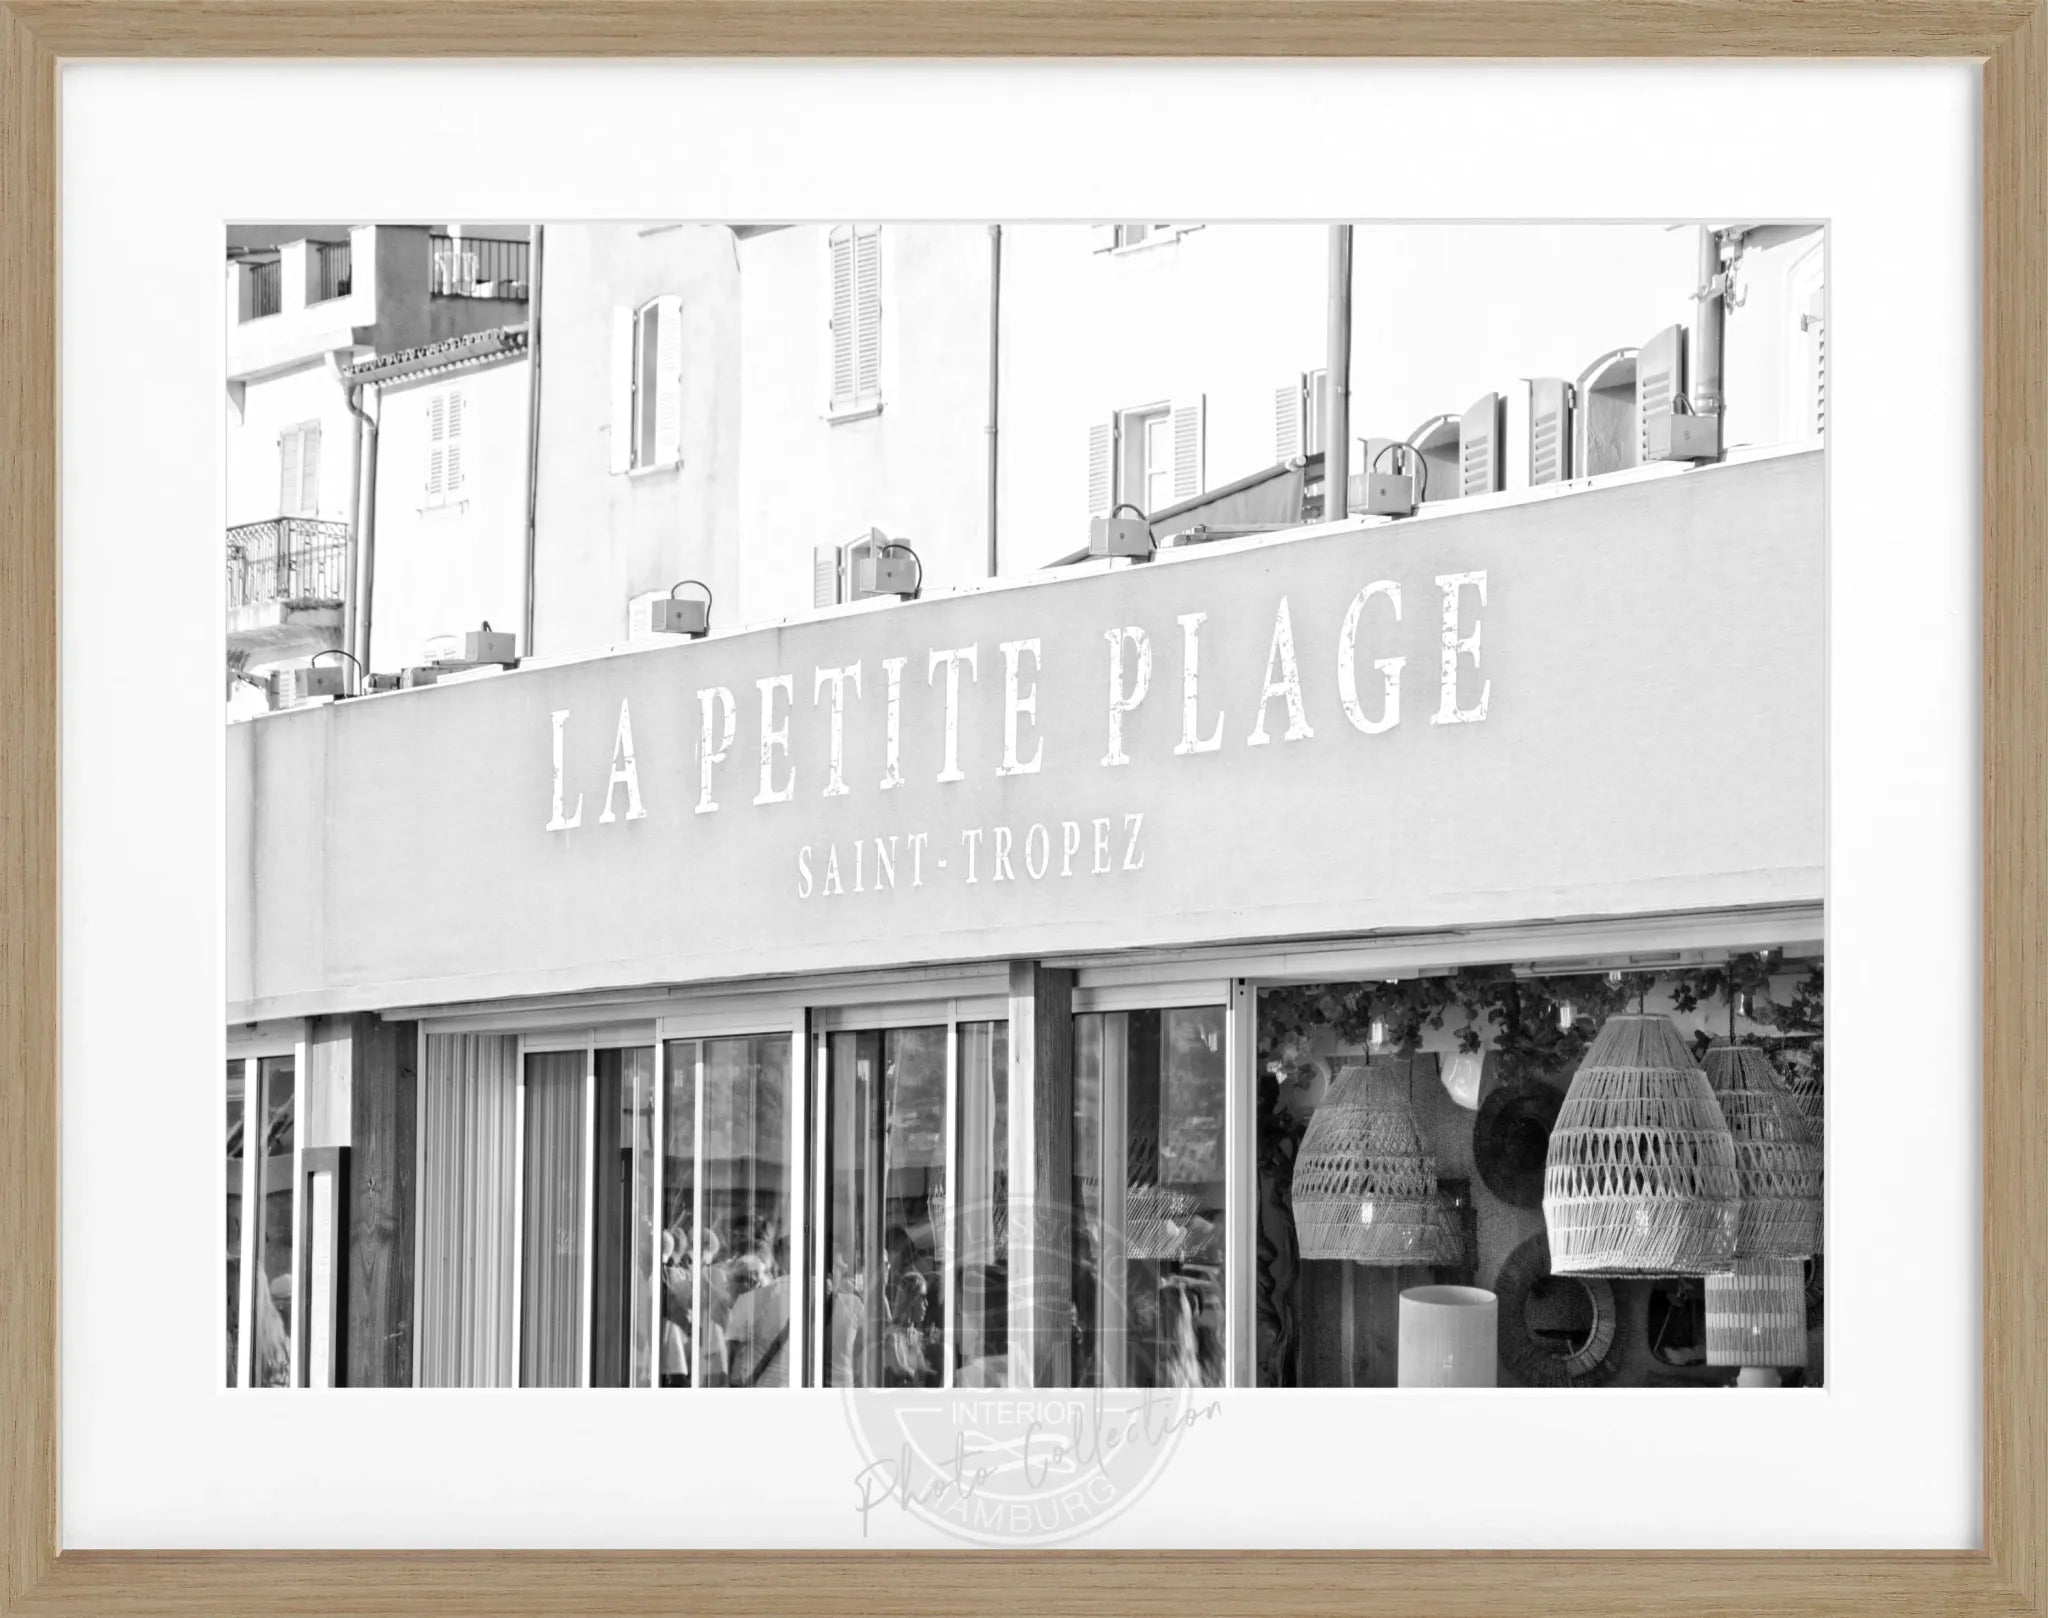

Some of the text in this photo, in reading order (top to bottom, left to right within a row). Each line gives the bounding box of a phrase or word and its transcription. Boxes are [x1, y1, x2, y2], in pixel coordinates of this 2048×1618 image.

[545, 569, 1492, 832] LA PETITE PLAGE
